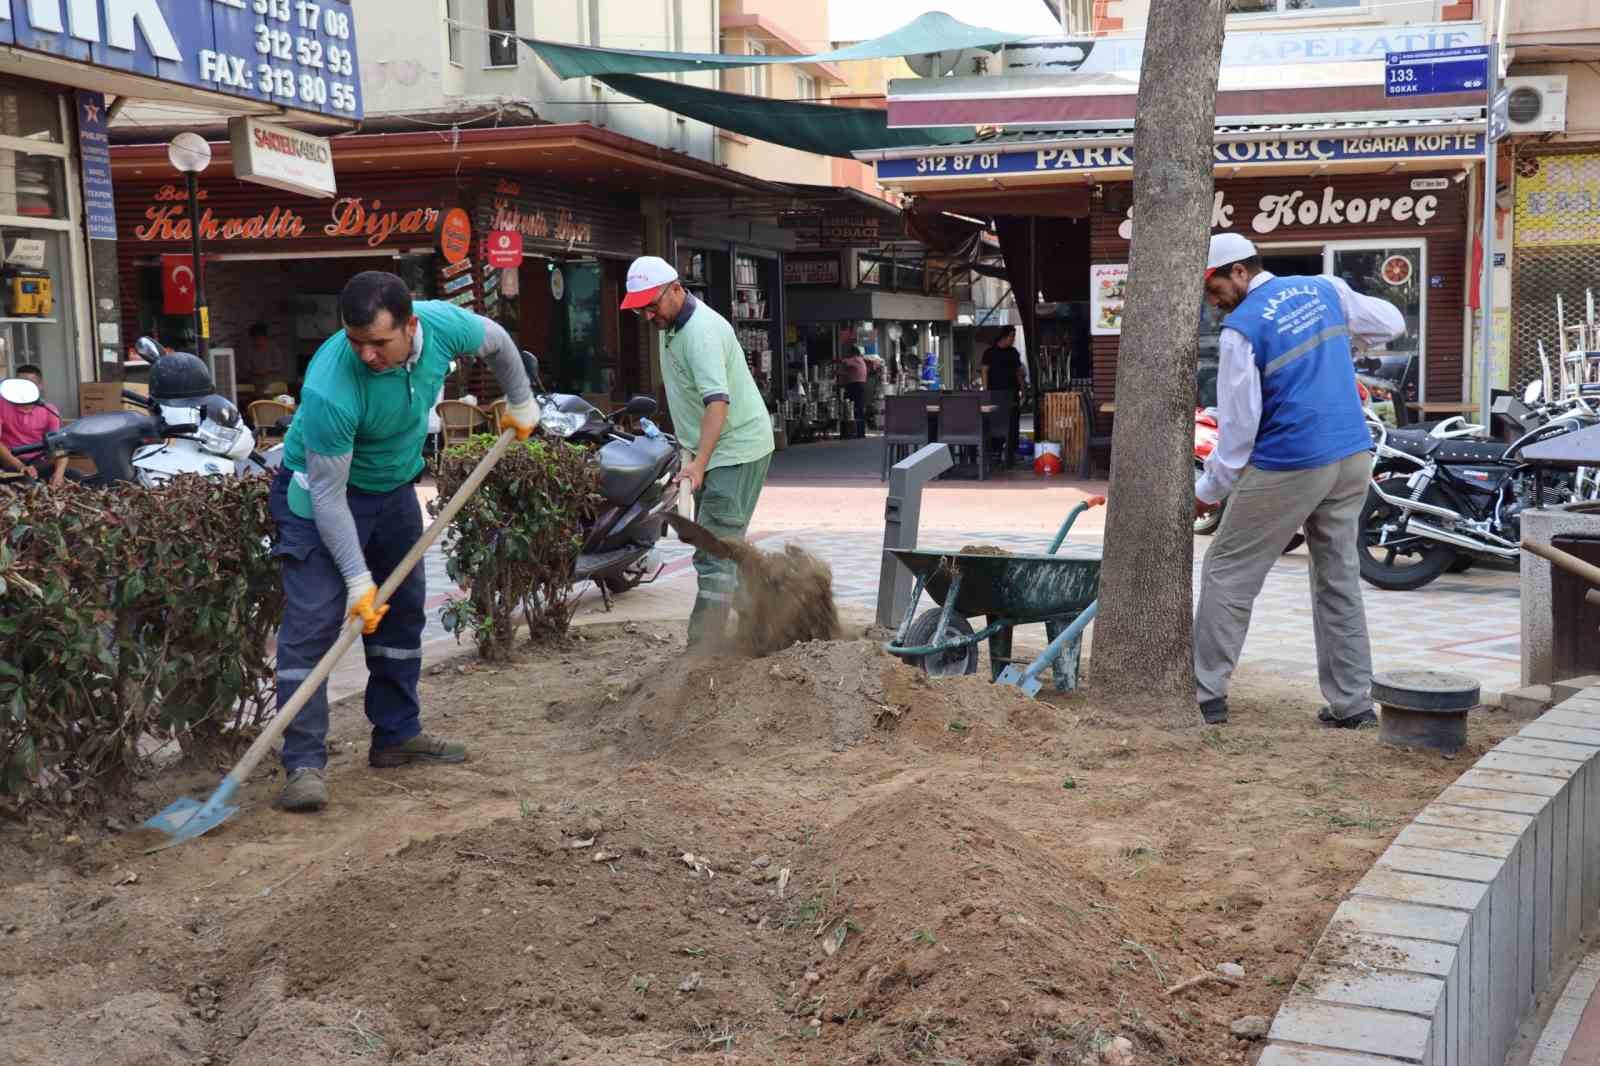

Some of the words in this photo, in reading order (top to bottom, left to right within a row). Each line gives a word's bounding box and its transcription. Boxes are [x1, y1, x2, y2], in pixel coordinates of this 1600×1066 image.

[295, 2, 320, 30] 17
[324, 9, 350, 40] 08
[255, 24, 293, 60] 312
[296, 37, 324, 68] 52
[327, 45, 353, 76] 93
[199, 49, 254, 89] FAX:
[257, 64, 296, 98] 313
[300, 75, 327, 105] 80
[331, 82, 356, 111] 55
[1390, 68, 1417, 83] 133.
[1390, 84, 1418, 94] SOKAK
[916, 156, 947, 173] 312
[953, 155, 972, 171] 87
[980, 153, 999, 169] 01
[1035, 146, 1134, 169] PARK
[1251, 186, 1438, 234] Kokoreç
